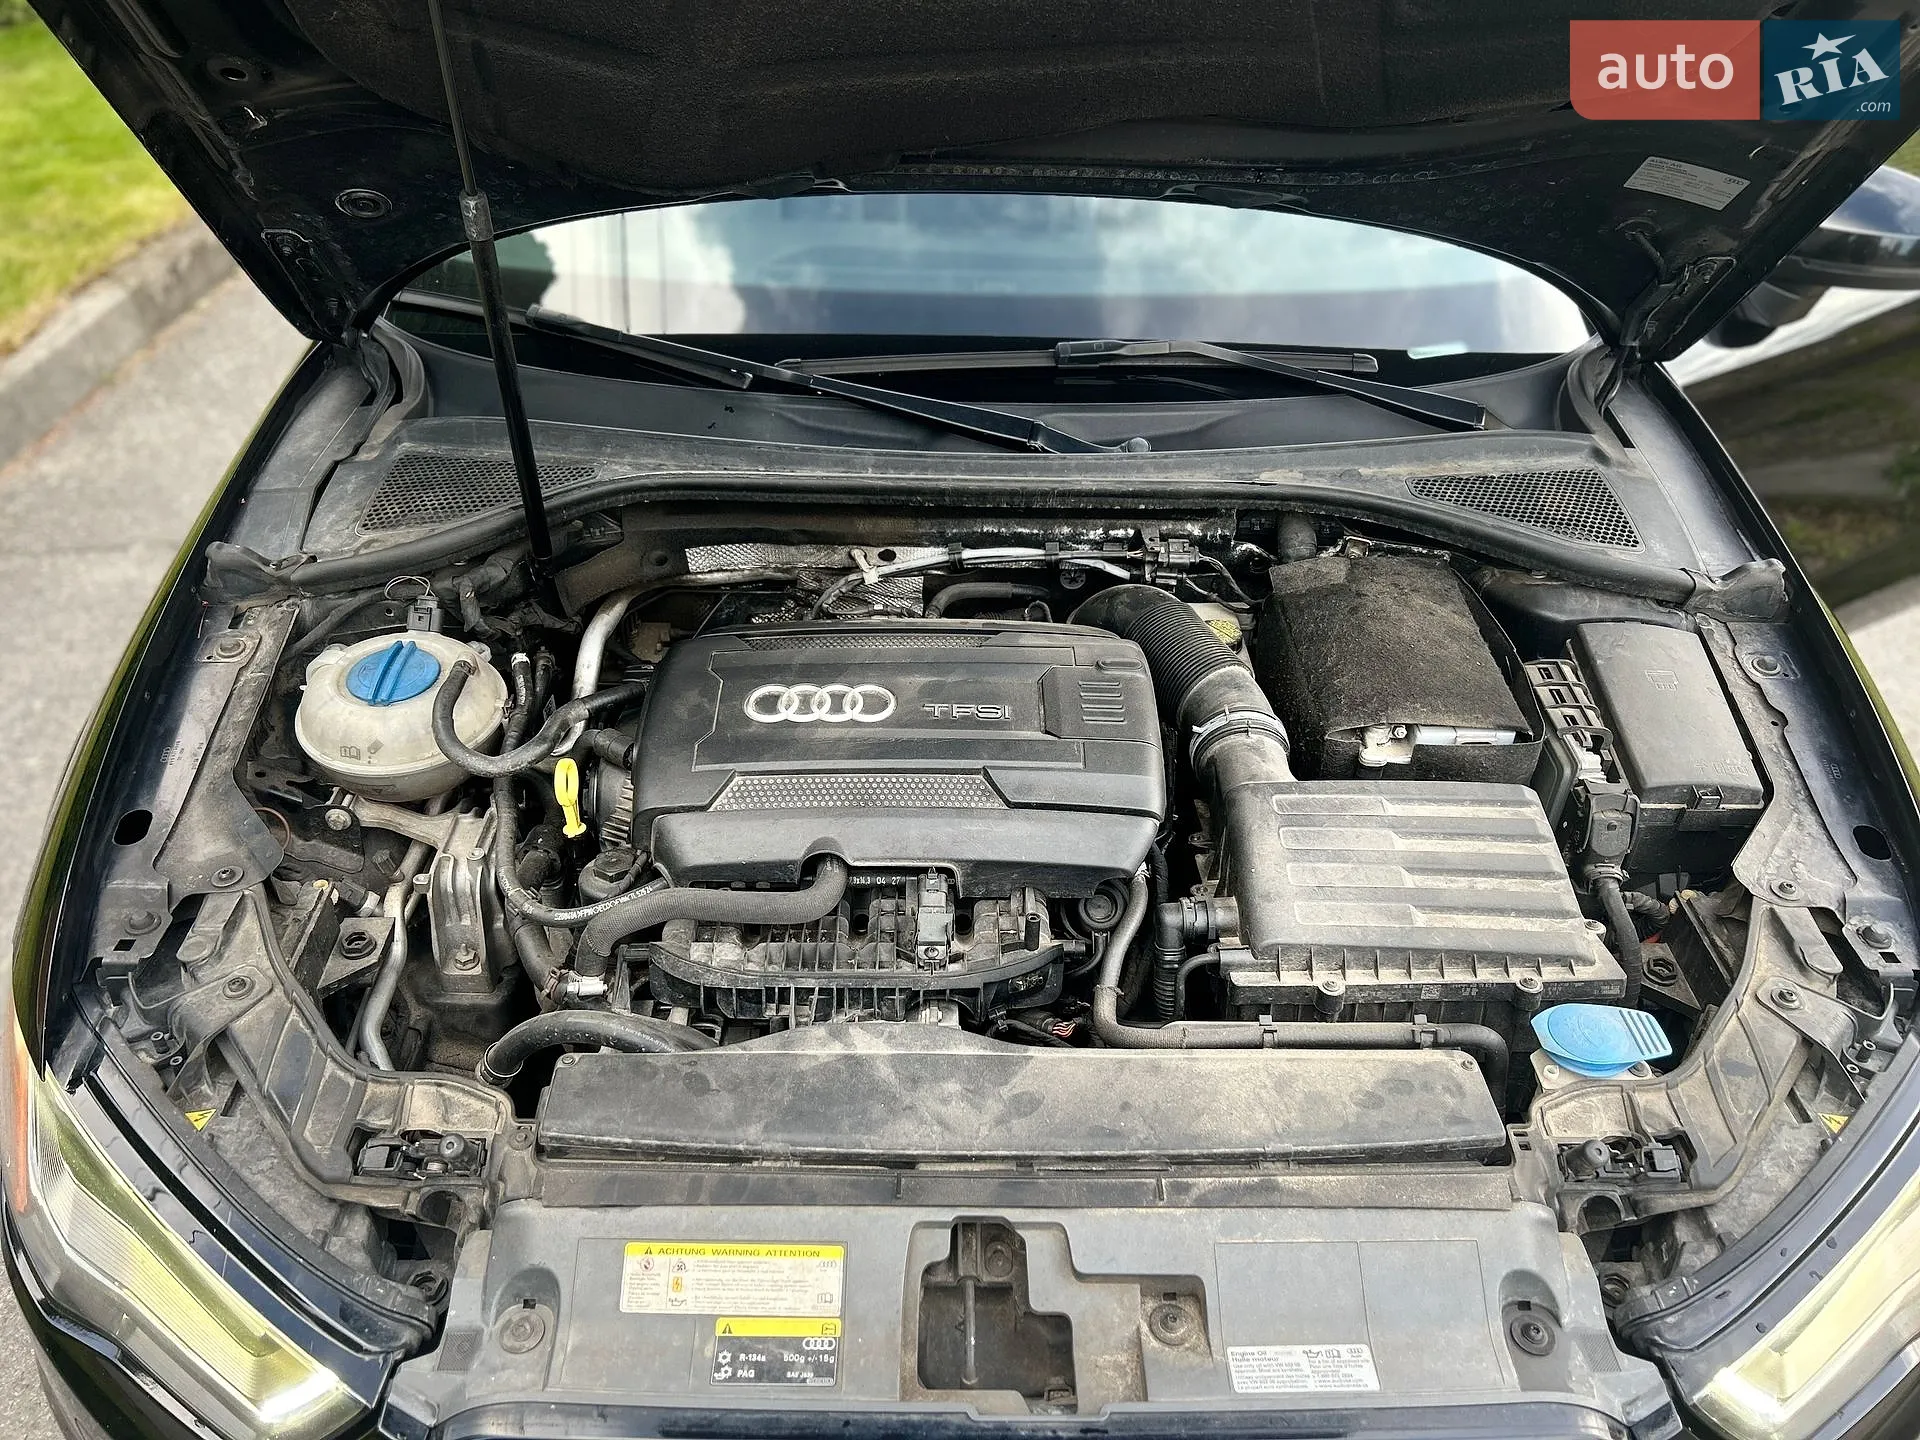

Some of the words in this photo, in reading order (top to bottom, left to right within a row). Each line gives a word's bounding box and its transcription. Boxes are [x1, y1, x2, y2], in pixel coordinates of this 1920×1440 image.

[922, 702, 1012, 721] TFSI
[658, 1248, 706, 1256] ACHTUNG
[711, 1248, 760, 1257] WARNING
[765, 1249, 820, 1257] ATTENTION
[737, 1370, 755, 1378] PAG
